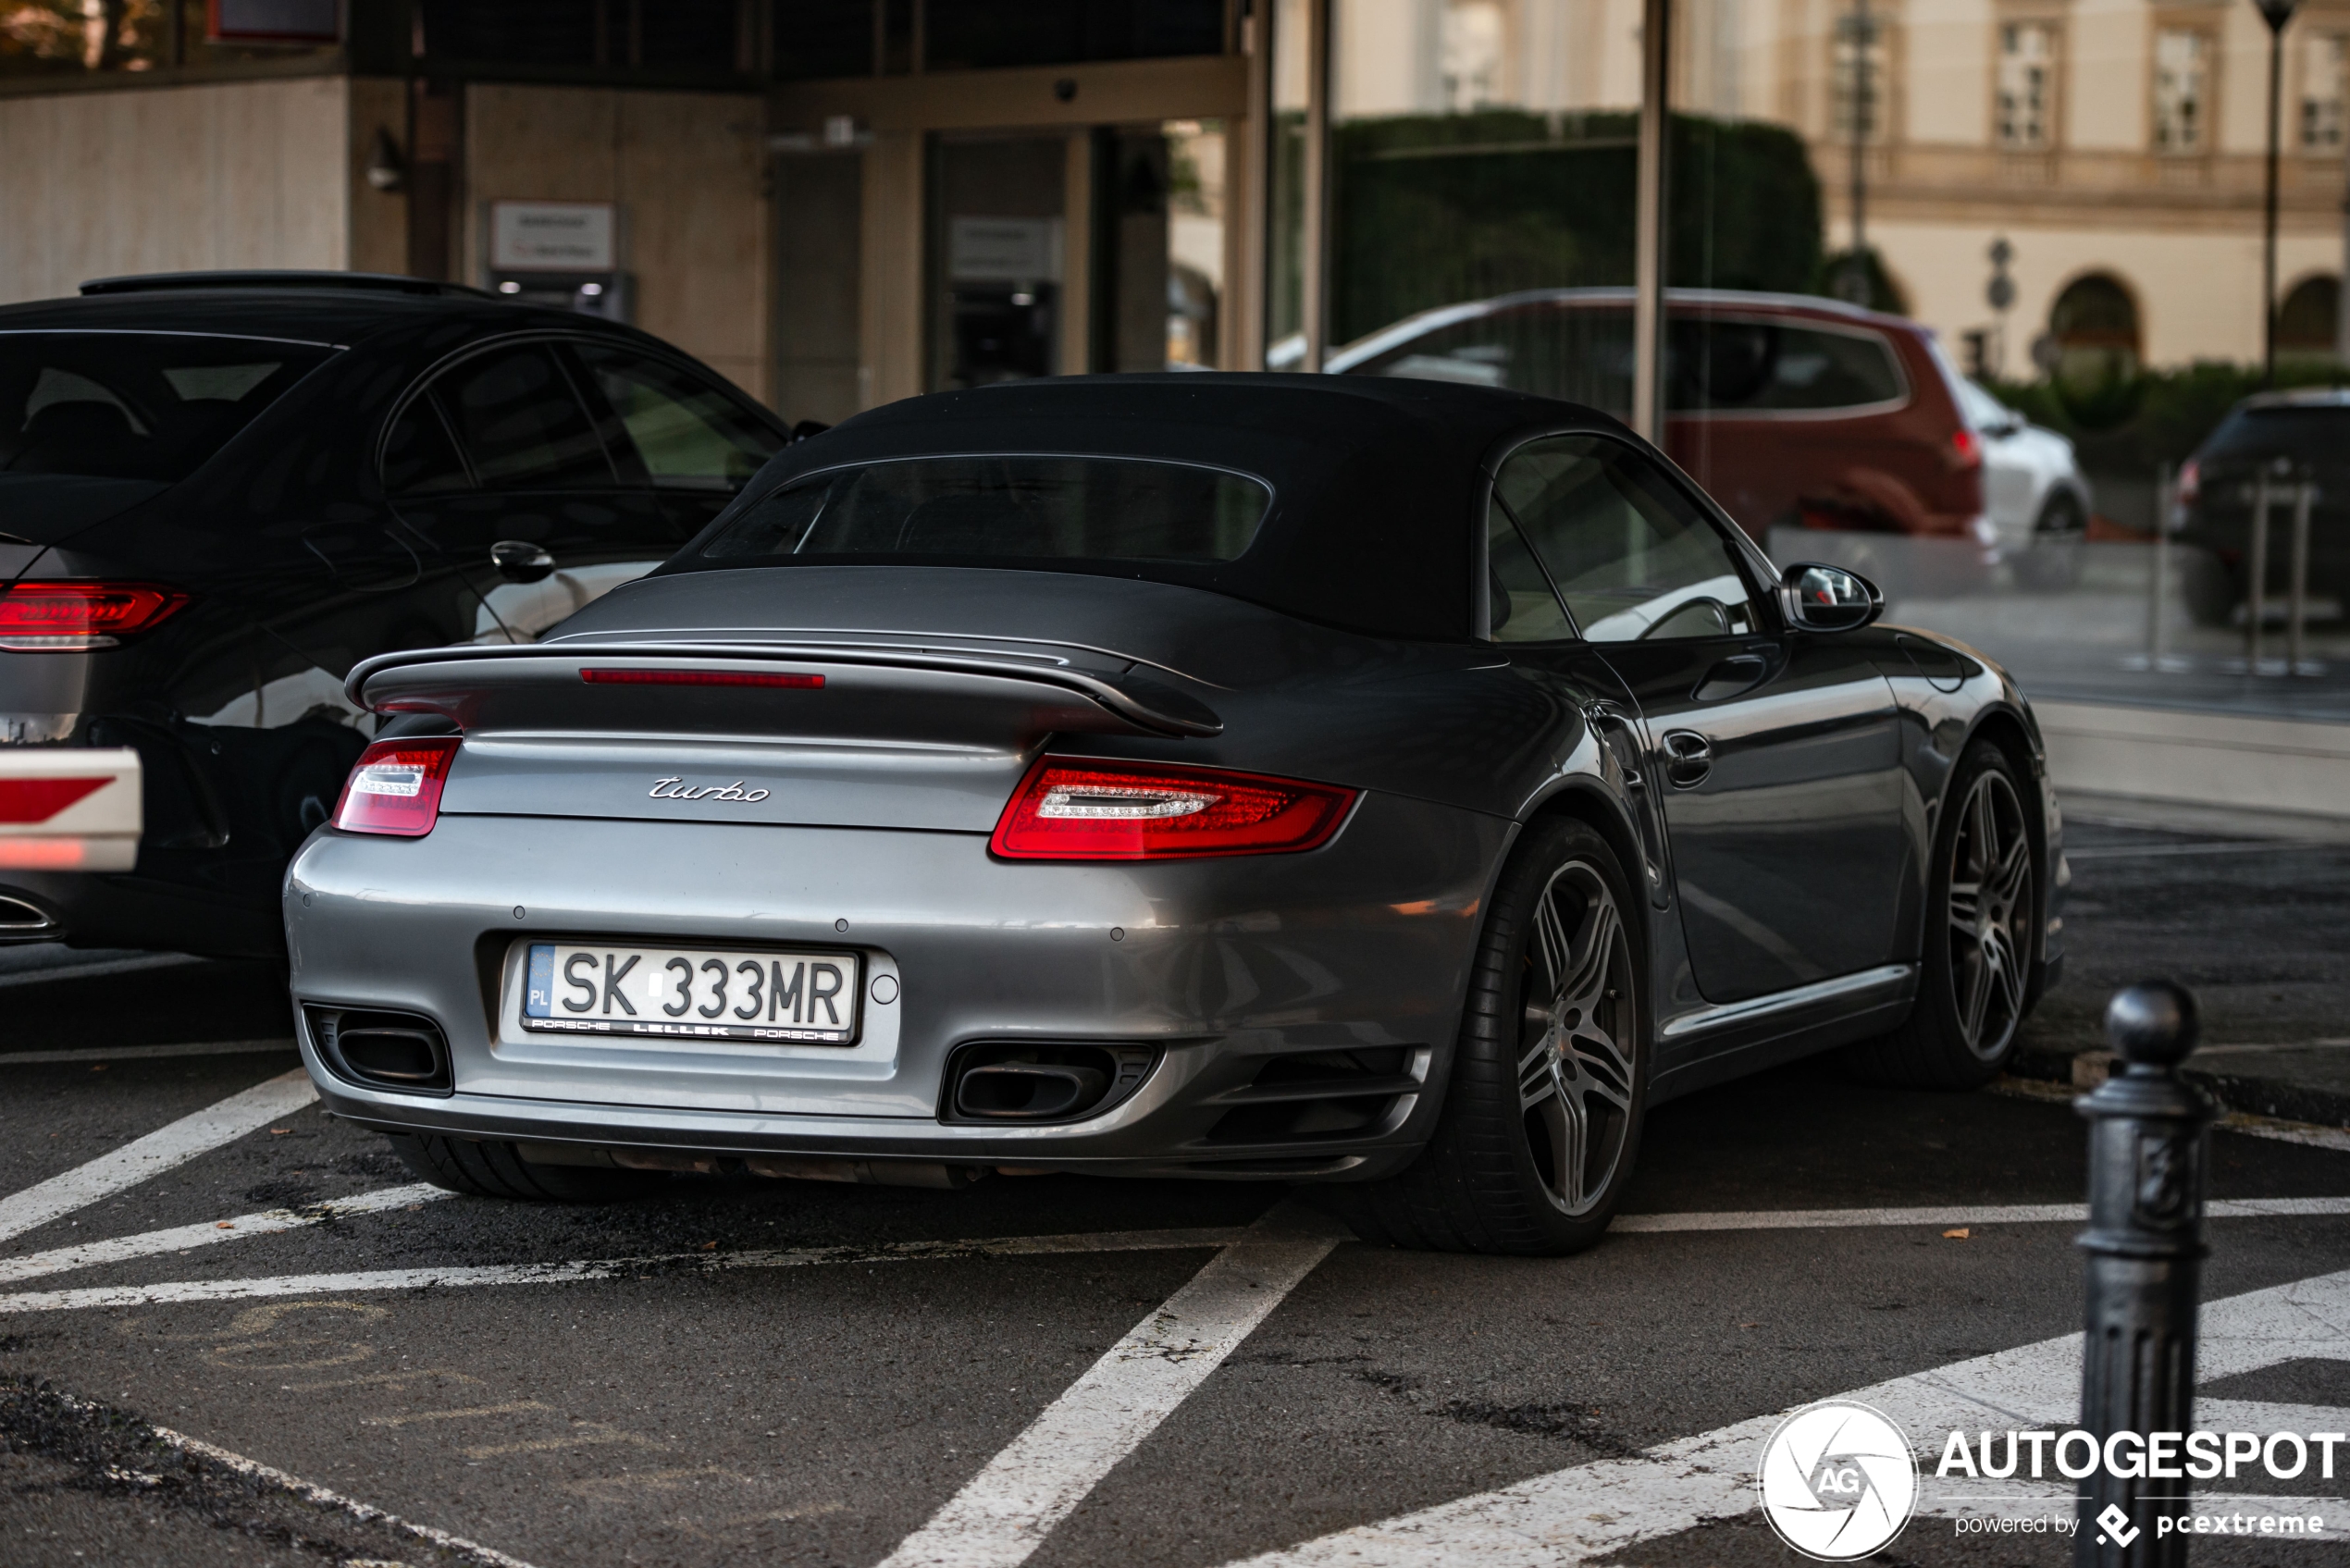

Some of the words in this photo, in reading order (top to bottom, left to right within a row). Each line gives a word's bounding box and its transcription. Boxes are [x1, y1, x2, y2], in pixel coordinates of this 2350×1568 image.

[529, 989, 549, 1006] PL
[562, 952, 641, 1016] SK
[662, 957, 843, 1024] 333MR
[531, 1019, 611, 1031] PORSCHE
[633, 1023, 729, 1036] LELLEK
[754, 1029, 839, 1042] PORSCHE
